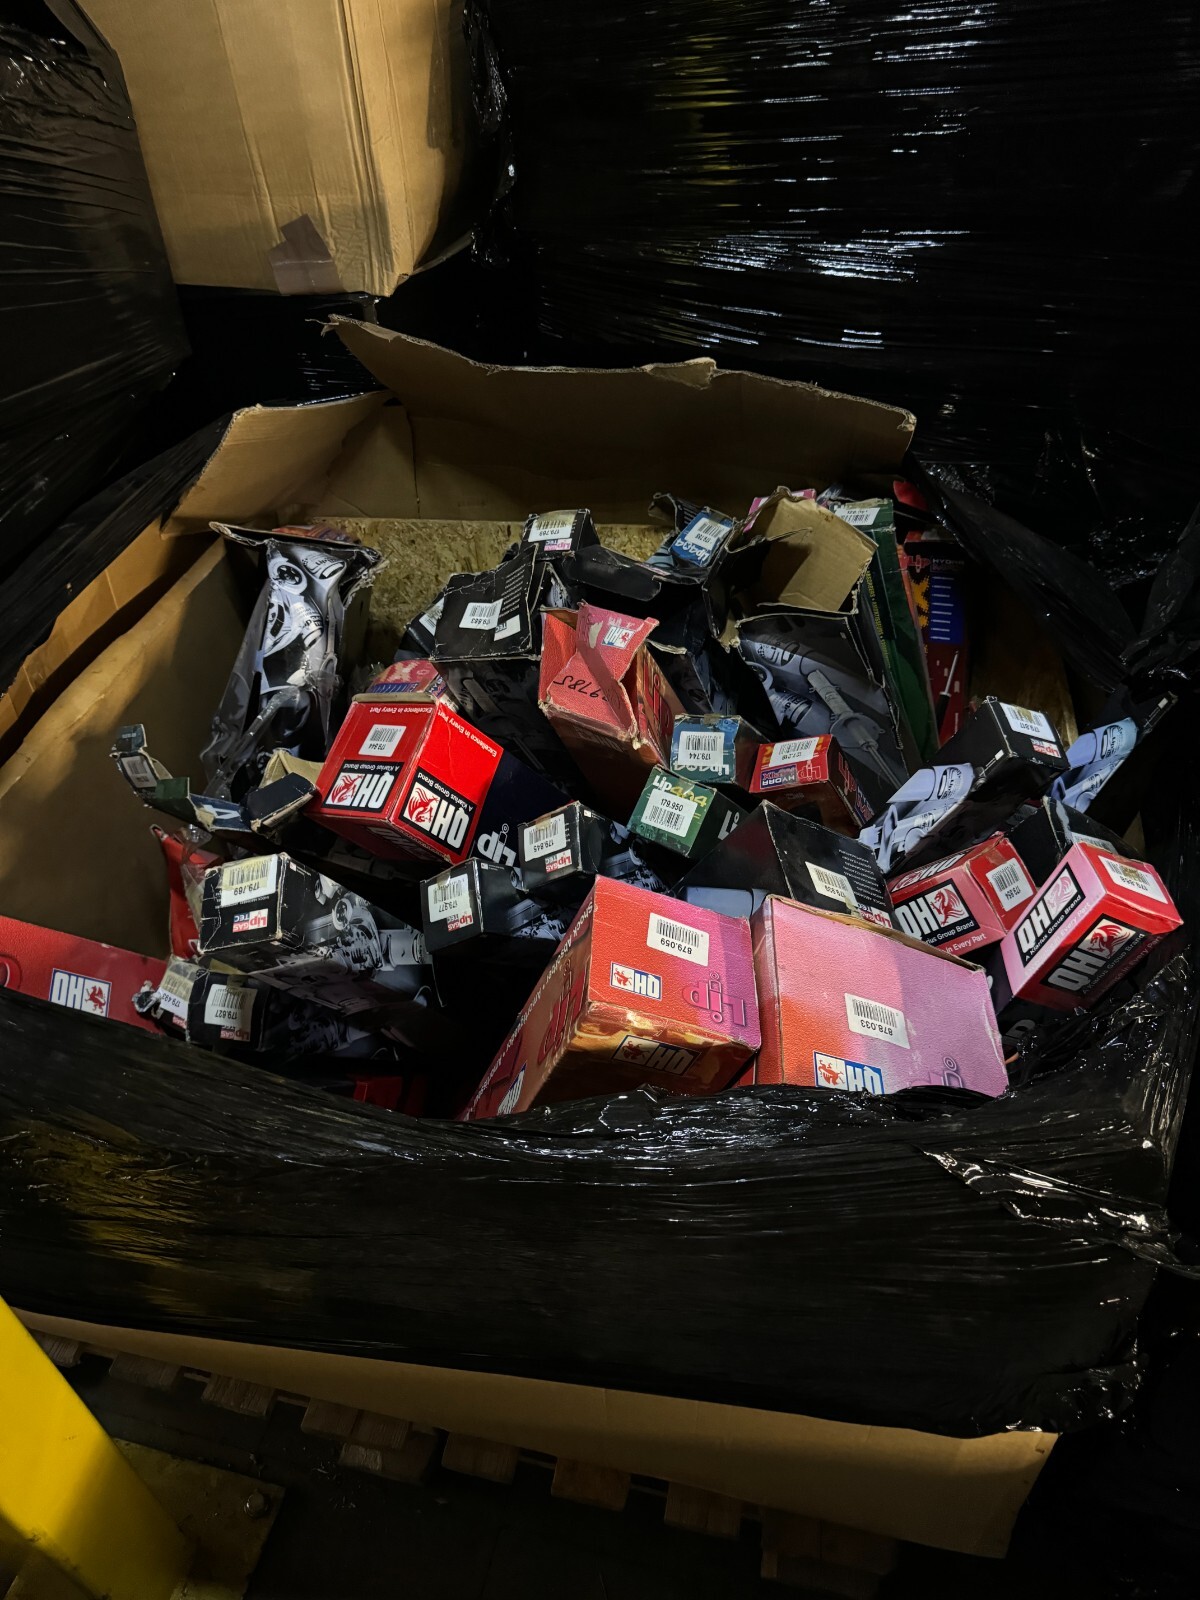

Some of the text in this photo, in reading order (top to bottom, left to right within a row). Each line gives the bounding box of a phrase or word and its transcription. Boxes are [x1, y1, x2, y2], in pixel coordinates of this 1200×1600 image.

[370, 706, 381, 714] Part
[382, 706, 397, 714] Every
[404, 706, 432, 714] Excellence
[437, 711, 498, 758] Excellence in Every Part
[689, 752, 711, 760] 179.744
[376, 764, 394, 772] Klarius
[418, 771, 434, 787] Brand
[352, 772, 395, 809] QH
[434, 782, 450, 798] Group
[450, 792, 468, 810] Klarius
[660, 798, 683, 812] 179.950
[431, 796, 470, 849] QH
[546, 854, 571, 872] Lip GAS
[234, 914, 249, 922] TEC
[572, 901, 593, 935] Shock
[894, 896, 940, 940] QH
[1077, 902, 1091, 917] Part
[234, 914, 267, 930] Lip GAS
[448, 914, 473, 931] Lip GAS
[874, 913, 891, 928] Lip
[1016, 899, 1050, 954] QH
[1030, 934, 1048, 956] Klarius
[1047, 916, 1064, 934] Group
[1064, 895, 1081, 914] Brand
[937, 929, 956, 940] Group
[956, 920, 975, 933] Brand
[660, 937, 692, 955] 879.059
[953, 940, 972, 953] Every
[972, 932, 987, 942] Part
[1107, 952, 1126, 970] Group
[1127, 933, 1146, 952] Brand
[1147, 936, 1163, 950] Part
[546, 935, 572, 986] Absorber
[1047, 950, 1107, 992] QH
[51, 971, 84, 1010] QH
[634, 969, 661, 1000] QH
[681, 978, 746, 1027] Lip
[215, 1009, 238, 1020] 179.627
[220, 1030, 234, 1039] GAS
[860, 1020, 893, 1036] 878.033
